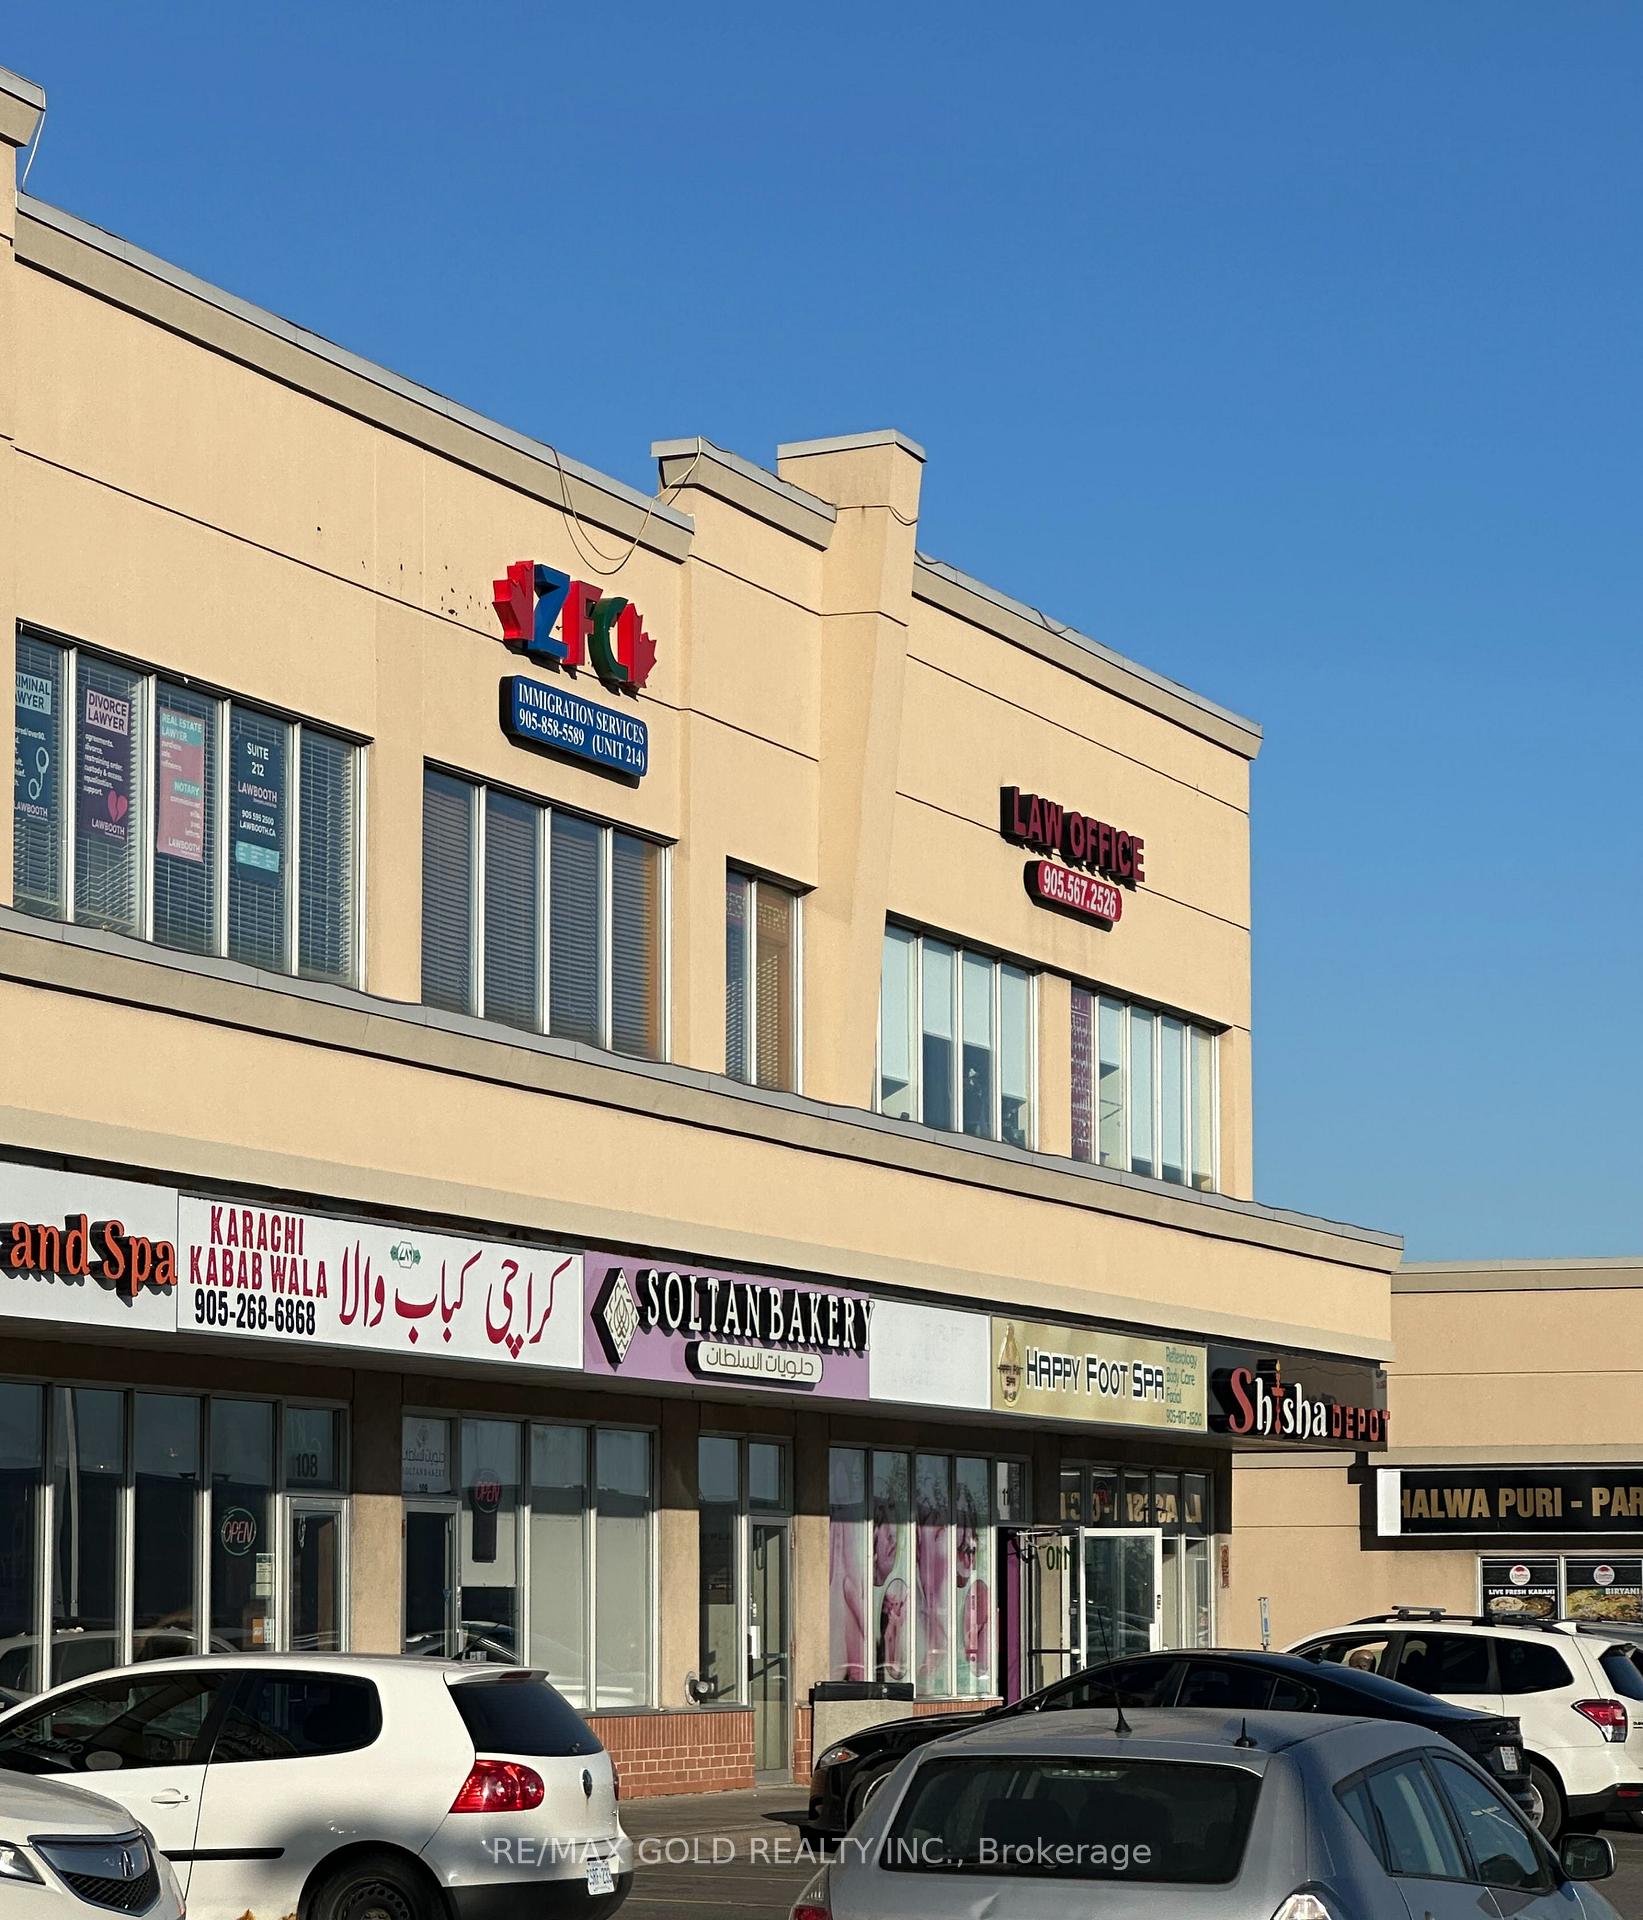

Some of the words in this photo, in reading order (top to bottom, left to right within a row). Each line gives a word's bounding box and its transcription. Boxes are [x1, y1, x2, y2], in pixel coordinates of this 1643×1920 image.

[532, 564, 629, 682] ZFC
[16, 675, 50, 695] IMINAL
[16, 690, 44, 709] WYER
[89, 693, 127, 717] DIVORCE
[88, 708, 125, 731] LAWYER
[162, 713, 178, 726] REAL
[179, 718, 203, 733] ESTATE
[519, 683, 594, 727] IMMIGRATION
[596, 711, 645, 745] SERVICES
[162, 726, 188, 741] LAWYER
[519, 708, 585, 746] 905-858-5589
[592, 735, 625, 763] (UNIT
[626, 744, 646, 771] 214)
[247, 742, 269, 760] SUITE
[251, 762, 265, 777] 212
[174, 781, 200, 797] NOTARY
[237, 781, 278, 803] LAWBOOTH
[91, 818, 125, 836] LAWBOOTH
[1012, 786, 1063, 850] LAW
[1069, 811, 1145, 883] OFFICE
[168, 836, 200, 852] LAWBOOTH
[1043, 865, 1117, 918] 905.567.2526
[210, 1205, 304, 1256] KARACHI
[11, 1213, 90, 1276] and
[103, 1220, 177, 1297] Spa
[190, 1245, 262, 1291] KABAB
[270, 1255, 328, 1299] WALA
[194, 1288, 316, 1336] 905-268-6868
[1026, 1348, 1081, 1392] HAPPY
[1086, 1355, 1129, 1397] FOOT
[1132, 1362, 1165, 1402] SPA
[1229, 1361, 1328, 1440] Shisha
[1333, 1404, 1390, 1441] DEPOT
[296, 1453, 318, 1478] 108
[475, 1482, 501, 1503] OPEN
[1498, 1487, 1563, 1518] PURI
[1570, 1500, 1584, 1508] -
[223, 1521, 254, 1544] OPEN
[1605, 1587, 1640, 1596] BIRYANI
